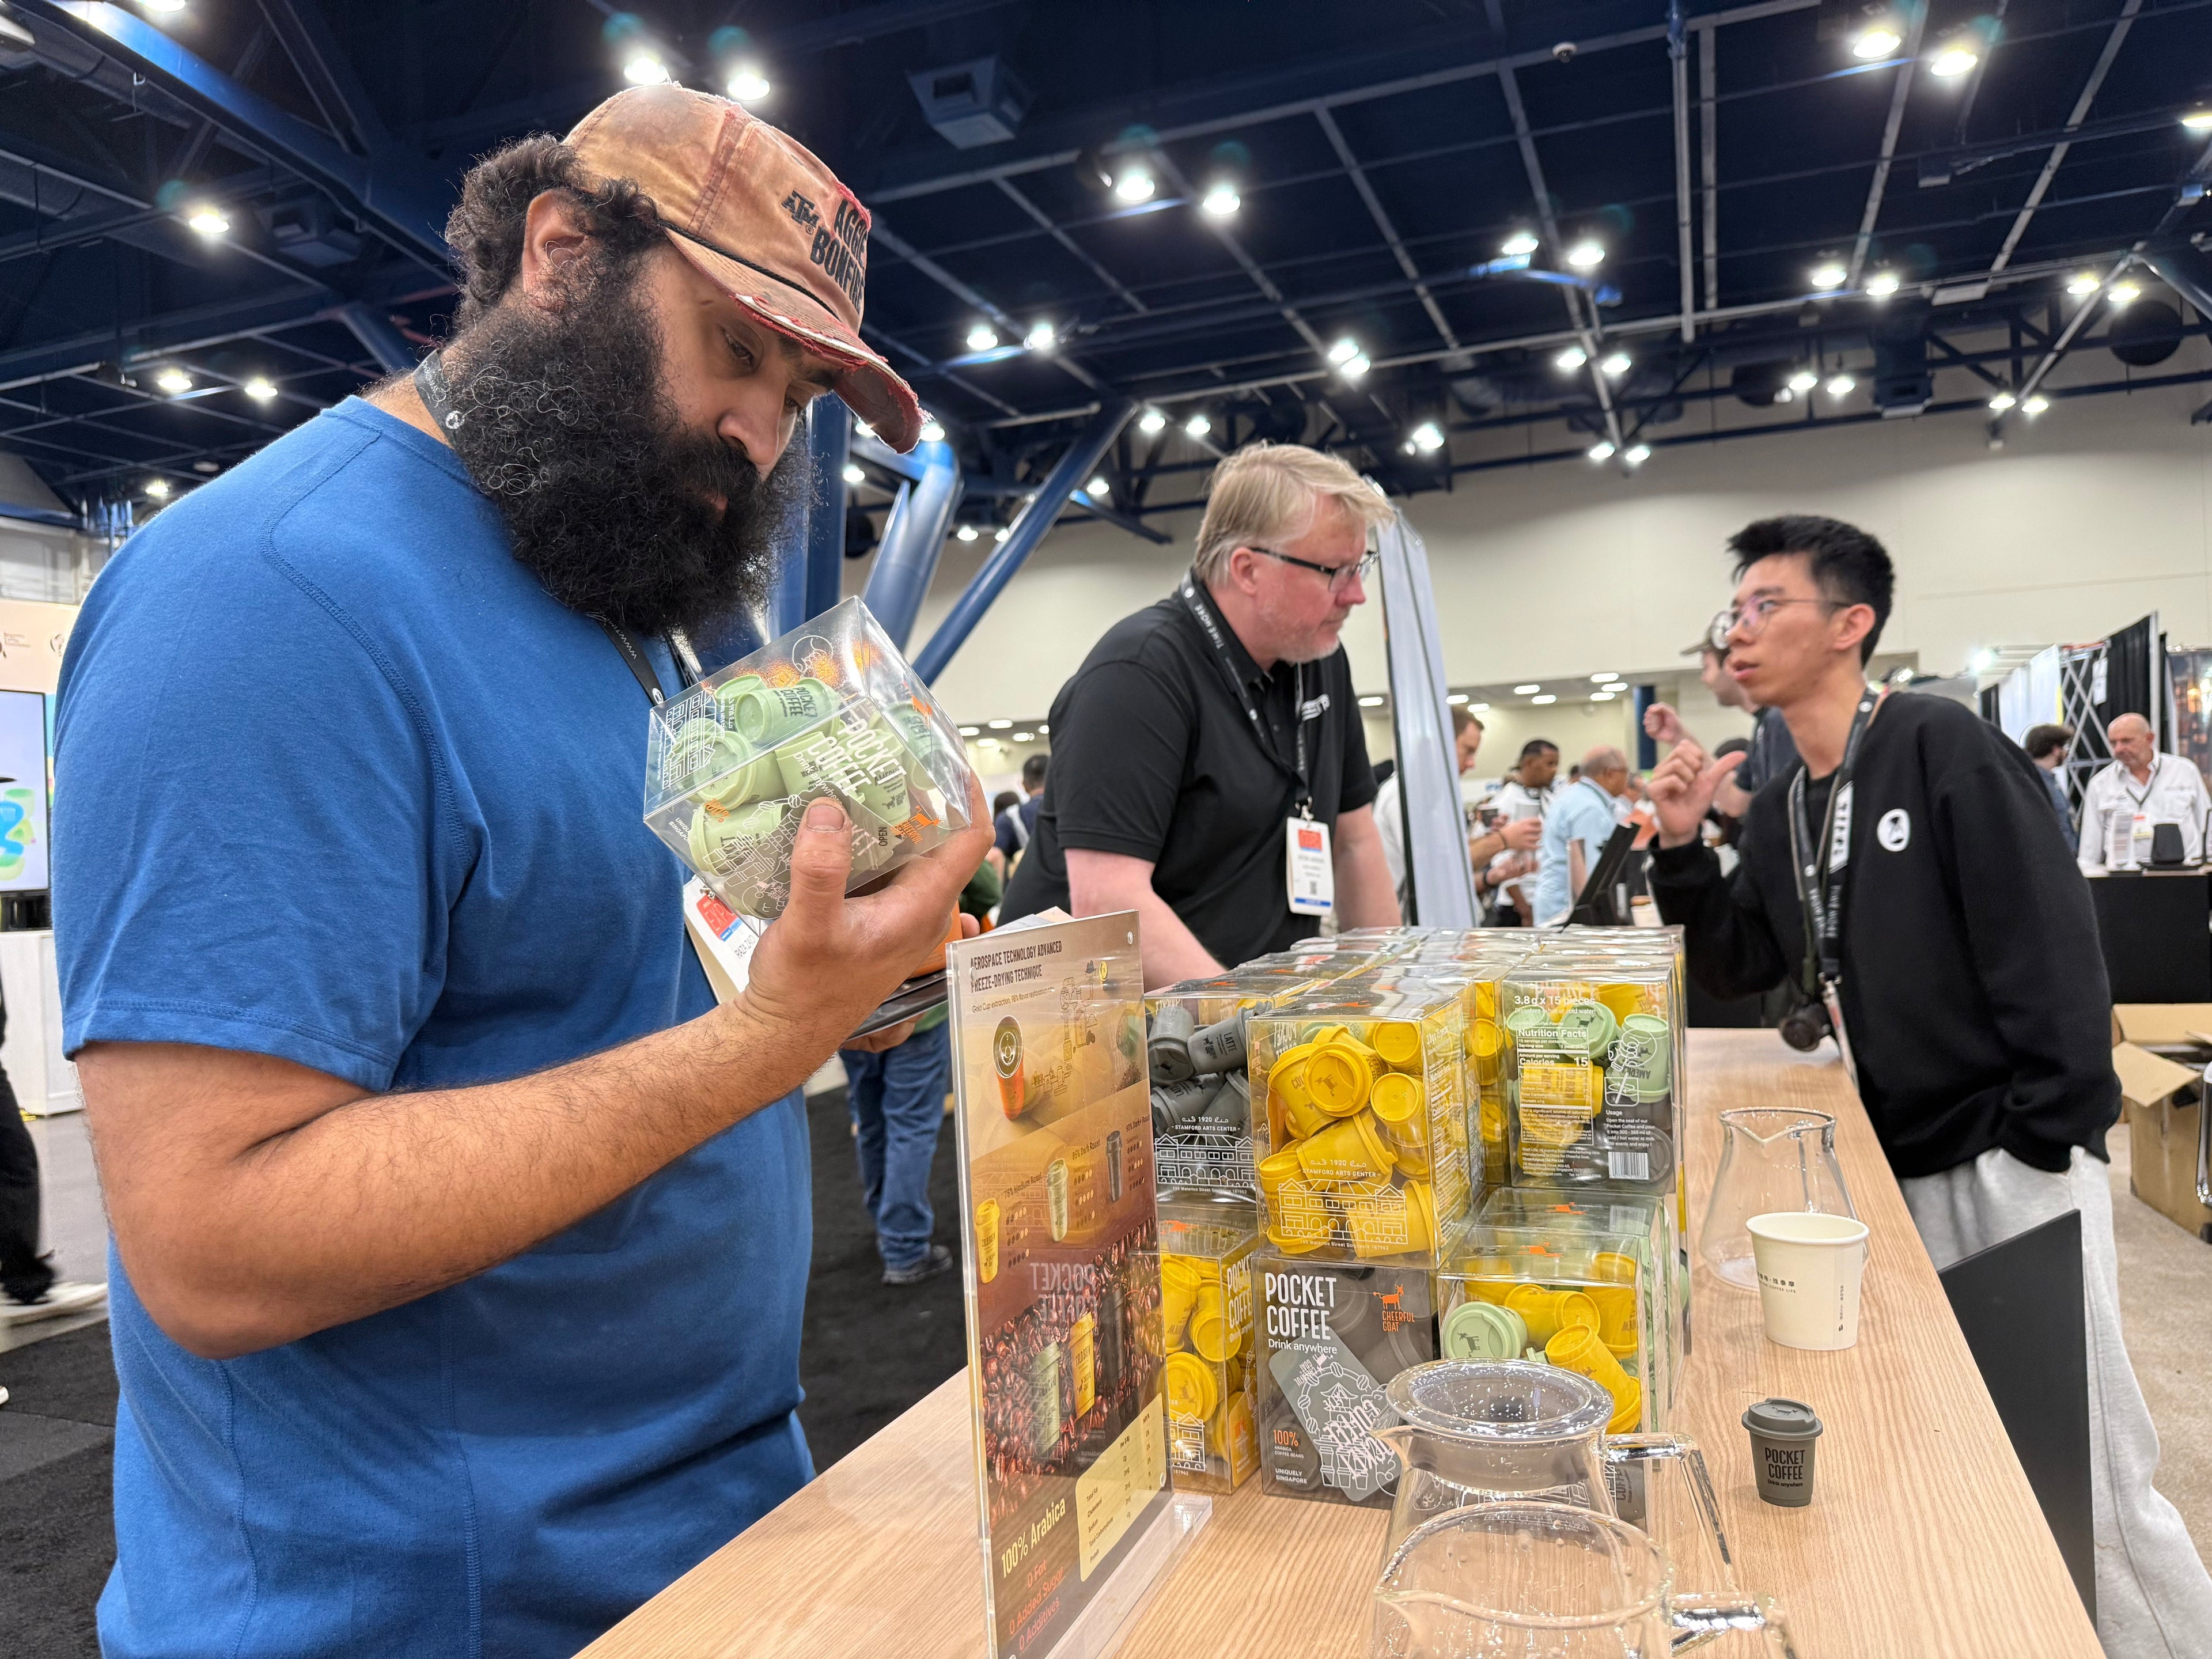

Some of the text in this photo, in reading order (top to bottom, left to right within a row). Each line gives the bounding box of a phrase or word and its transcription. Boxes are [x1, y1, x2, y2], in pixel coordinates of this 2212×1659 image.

[834, 198, 869, 269] AGGIE
[780, 690, 804, 717] COFFEE
[793, 687, 818, 718] POCKET
[838, 718, 907, 785] POCKET
[793, 751, 815, 774] Drink
[810, 772, 842, 805] anywher
[807, 736, 872, 797] COFFEE
[878, 826, 888, 847] OPEN
[899, 820, 923, 845] CHEERFUL
[734, 943, 748, 960] RAZA
[971, 940, 1062, 970] AEROSPACE TECHNOLOGY ADVANCED
[971, 964, 1042, 993] FREEZE-DRYING TECHNIQUE
[972, 1004, 982, 1013] Gold
[983, 1002, 991, 1011] Cup
[1019, 993, 1029, 1001] flavor
[1029, 988, 1048, 998] restoration
[1548, 997, 1561, 1005] 15
[1563, 996, 1596, 1007] pieces
[1224, 1031, 1237, 1052] LATTE
[1518, 1029, 1587, 1038] Nutrition Facts
[1519, 1056, 1588, 1067] Calories 15
[1291, 1073, 1305, 1089] COL
[1072, 1149, 1081, 1160] 85%
[1089, 1138, 1101, 1150] Roast
[1003, 1187, 1013, 1199] 75%
[1031, 1172, 1042, 1184] Roast
[1227, 1253, 1251, 1297] POCKE
[1264, 1272, 1337, 1308] POCKET
[1229, 1288, 1252, 1329] COFFE
[1382, 1310, 1415, 1323] CHEERFUL
[1267, 1305, 1331, 1340] COFFEE
[1382, 1321, 1399, 1332] GOAT
[1268, 1338, 1338, 1355] Drink anywhere
[1273, 1429, 1299, 1447] 100%
[1339, 1437, 1395, 1480] OCKET
[1764, 1446, 1806, 1465] POCKET
[1275, 1468, 1302, 1476] UNIQUELY
[1275, 1474, 1308, 1484] SINGAPORE
[1768, 1463, 1804, 1480] COFFEE
[1001, 1497, 1066, 1578] 100% Arabica
[1027, 1558, 1047, 1588] 0 Fat
[1009, 1565, 1065, 1635] 0 Added Sugar
[1019, 1596, 1061, 1652] 0 Additives
